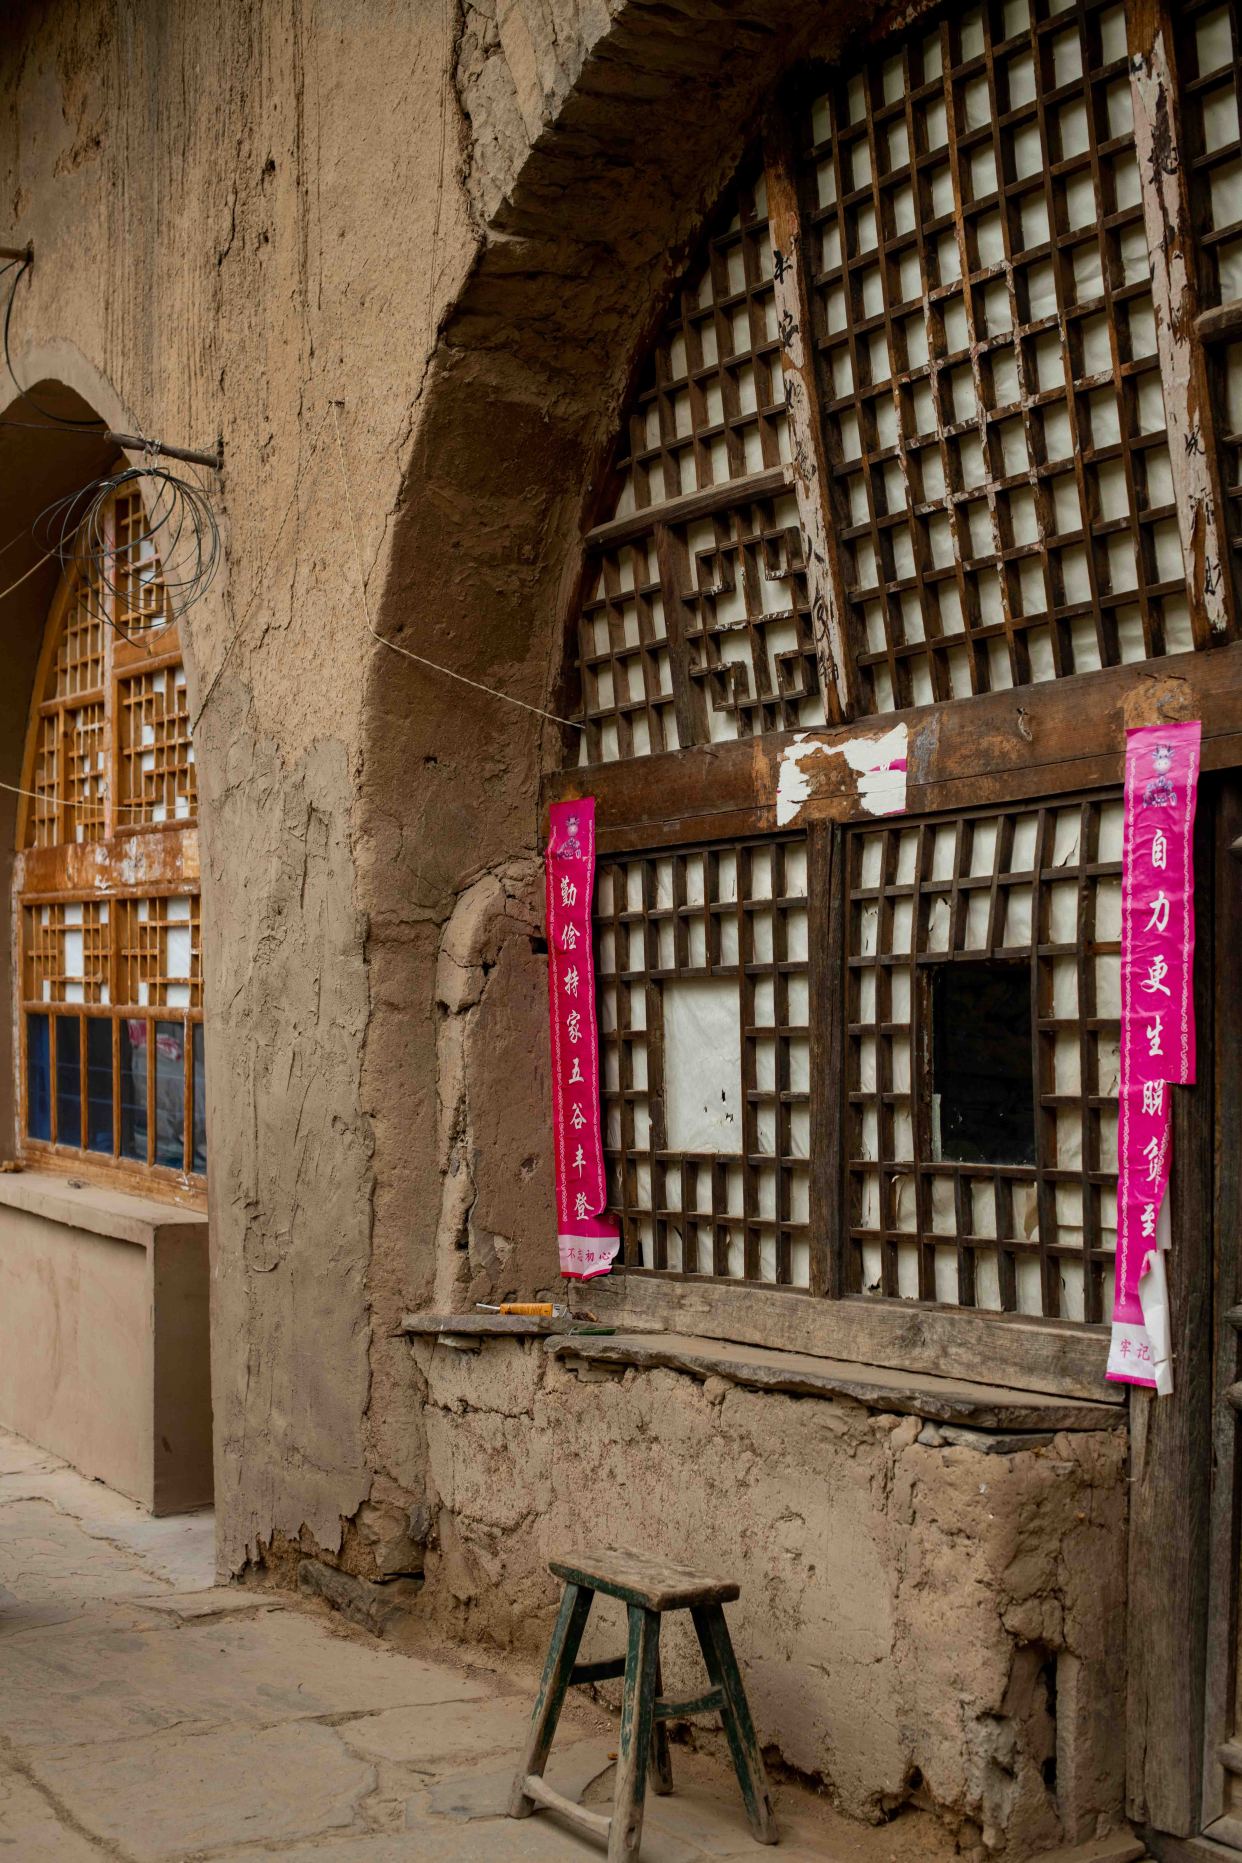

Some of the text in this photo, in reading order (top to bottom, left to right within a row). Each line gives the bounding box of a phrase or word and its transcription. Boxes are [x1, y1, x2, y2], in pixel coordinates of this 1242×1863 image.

[560, 875, 594, 1220] 勤俭持家五谷丰登
[1119, 1338, 1151, 1361] 牢记
